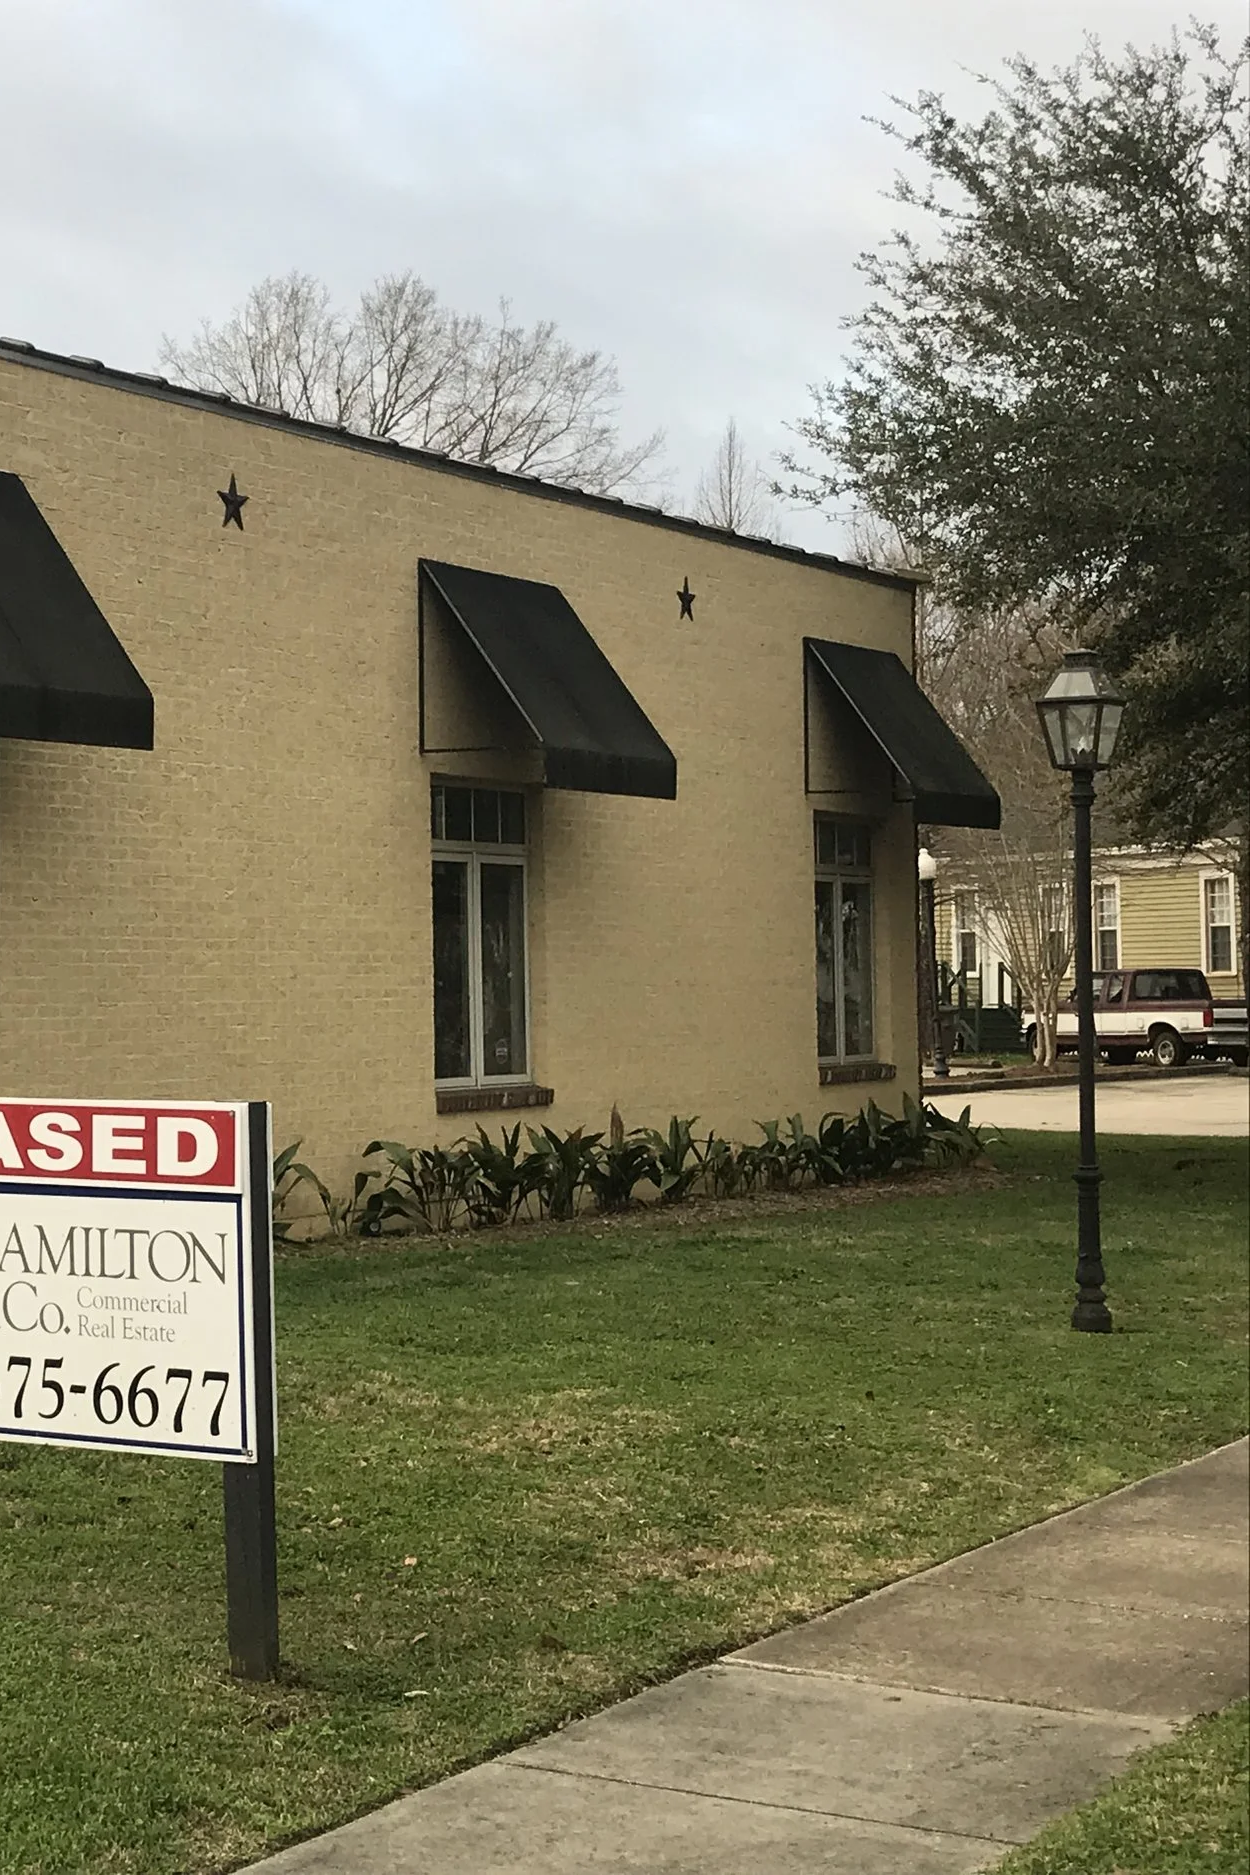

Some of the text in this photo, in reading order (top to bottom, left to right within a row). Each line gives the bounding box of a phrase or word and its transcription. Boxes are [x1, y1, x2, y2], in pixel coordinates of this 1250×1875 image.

[76, 1286, 188, 1314] Commercial
[77, 1314, 176, 1343] Real Estate
